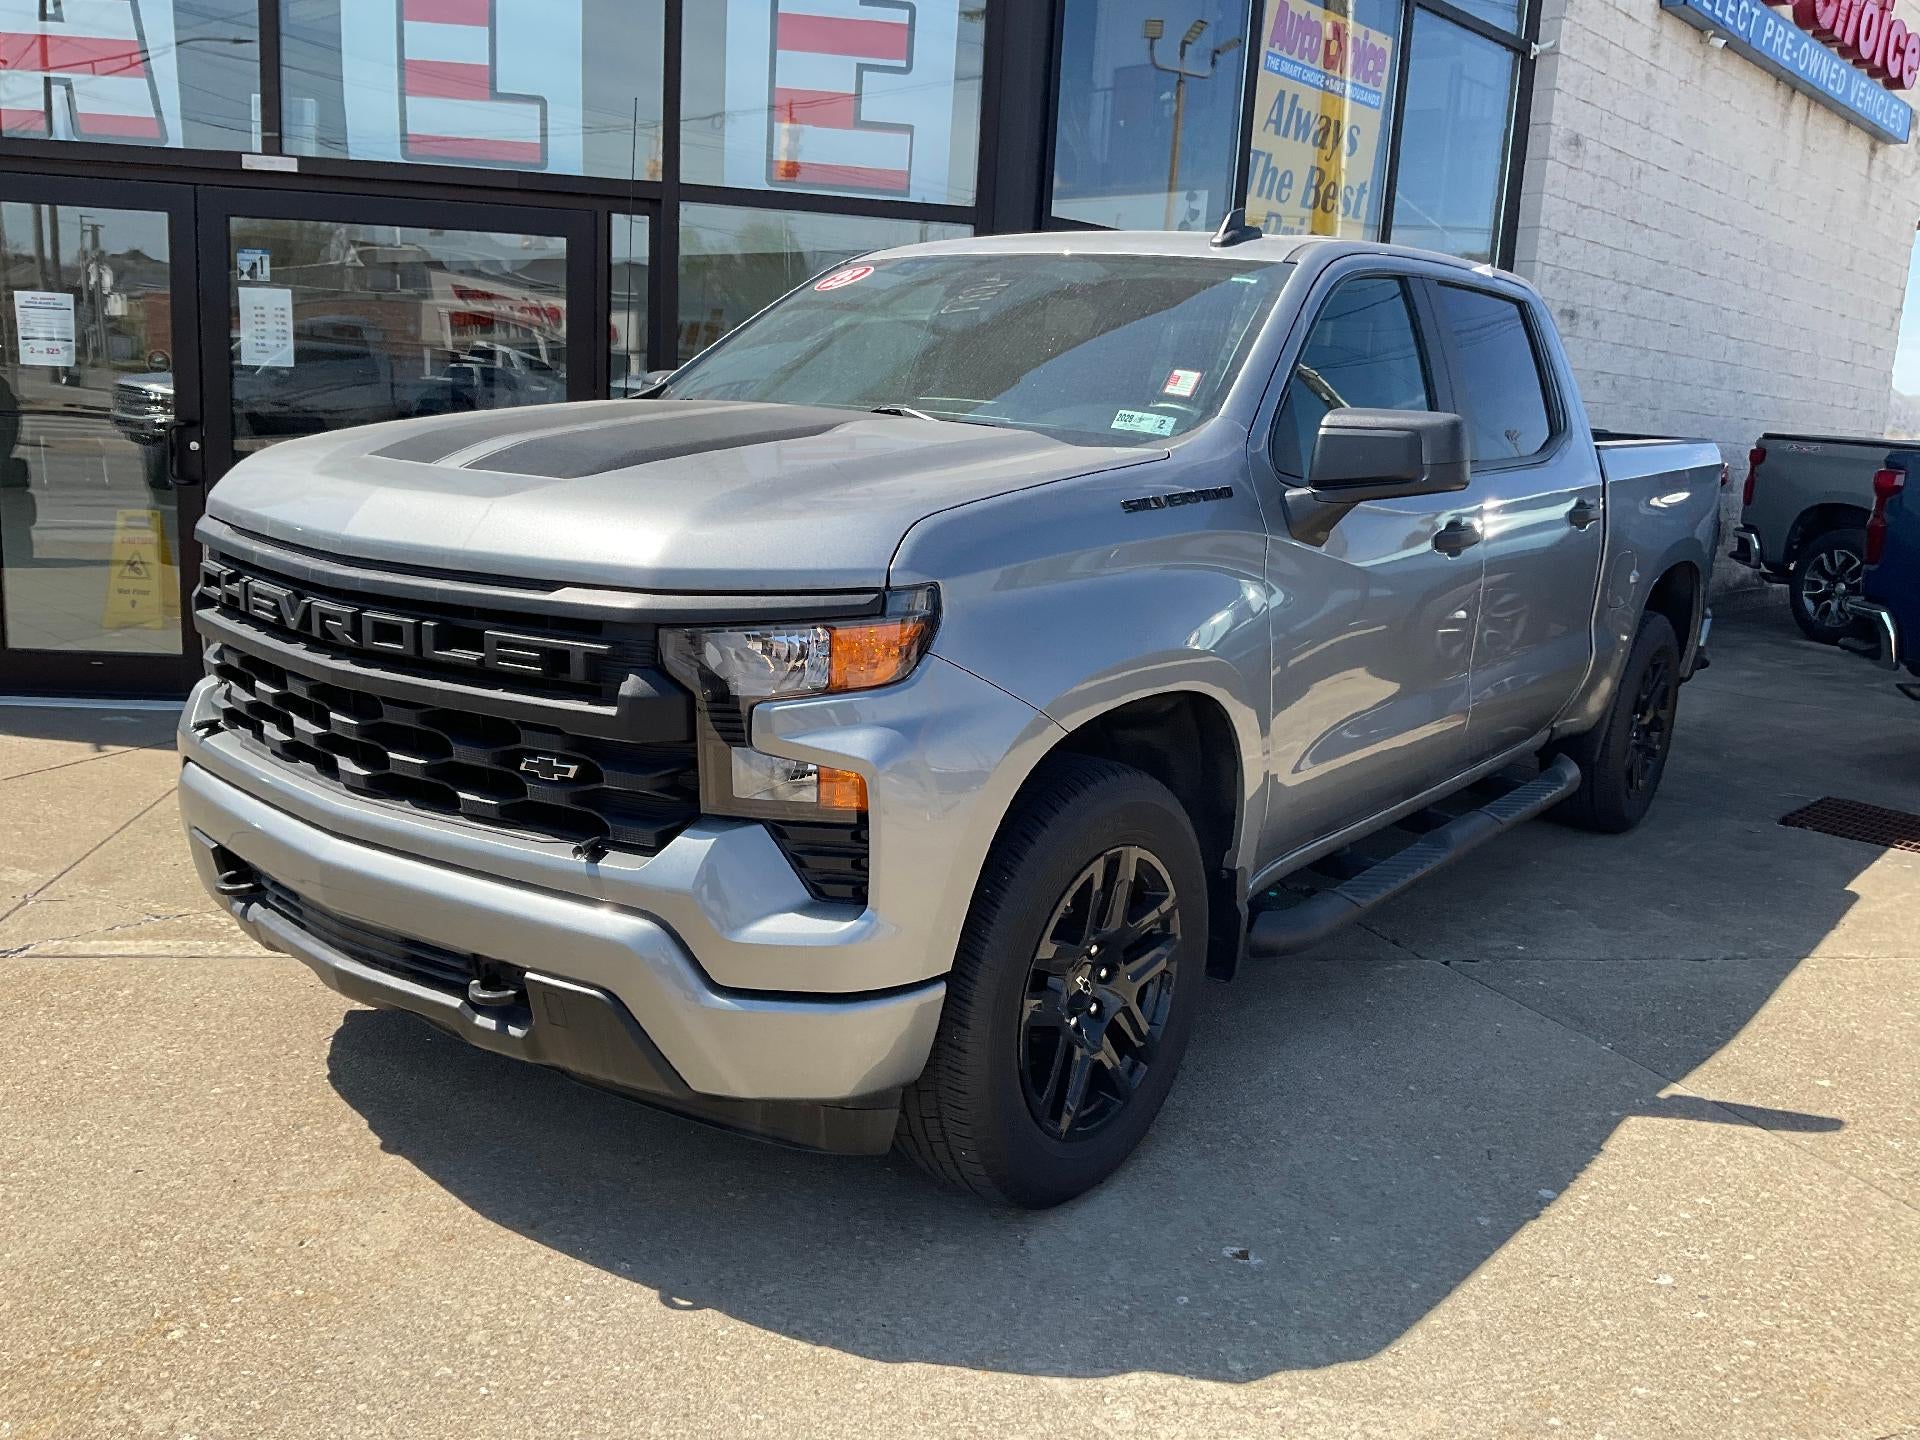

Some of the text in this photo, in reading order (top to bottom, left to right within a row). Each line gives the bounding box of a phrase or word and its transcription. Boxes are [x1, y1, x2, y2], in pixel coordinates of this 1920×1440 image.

[1266, 56, 1280, 72] THE
[1280, 60, 1302, 79] SMART
[1302, 67, 1326, 87] CHOICE
[1762, 18, 1847, 94] PRE-OWNED
[1850, 76, 1904, 132] VEHICLES
[1262, 89, 1361, 162] Always
[1248, 148, 1368, 219] The Best
[1157, 419, 1166, 429] 2
[199, 559, 614, 681] CHEVROLET
